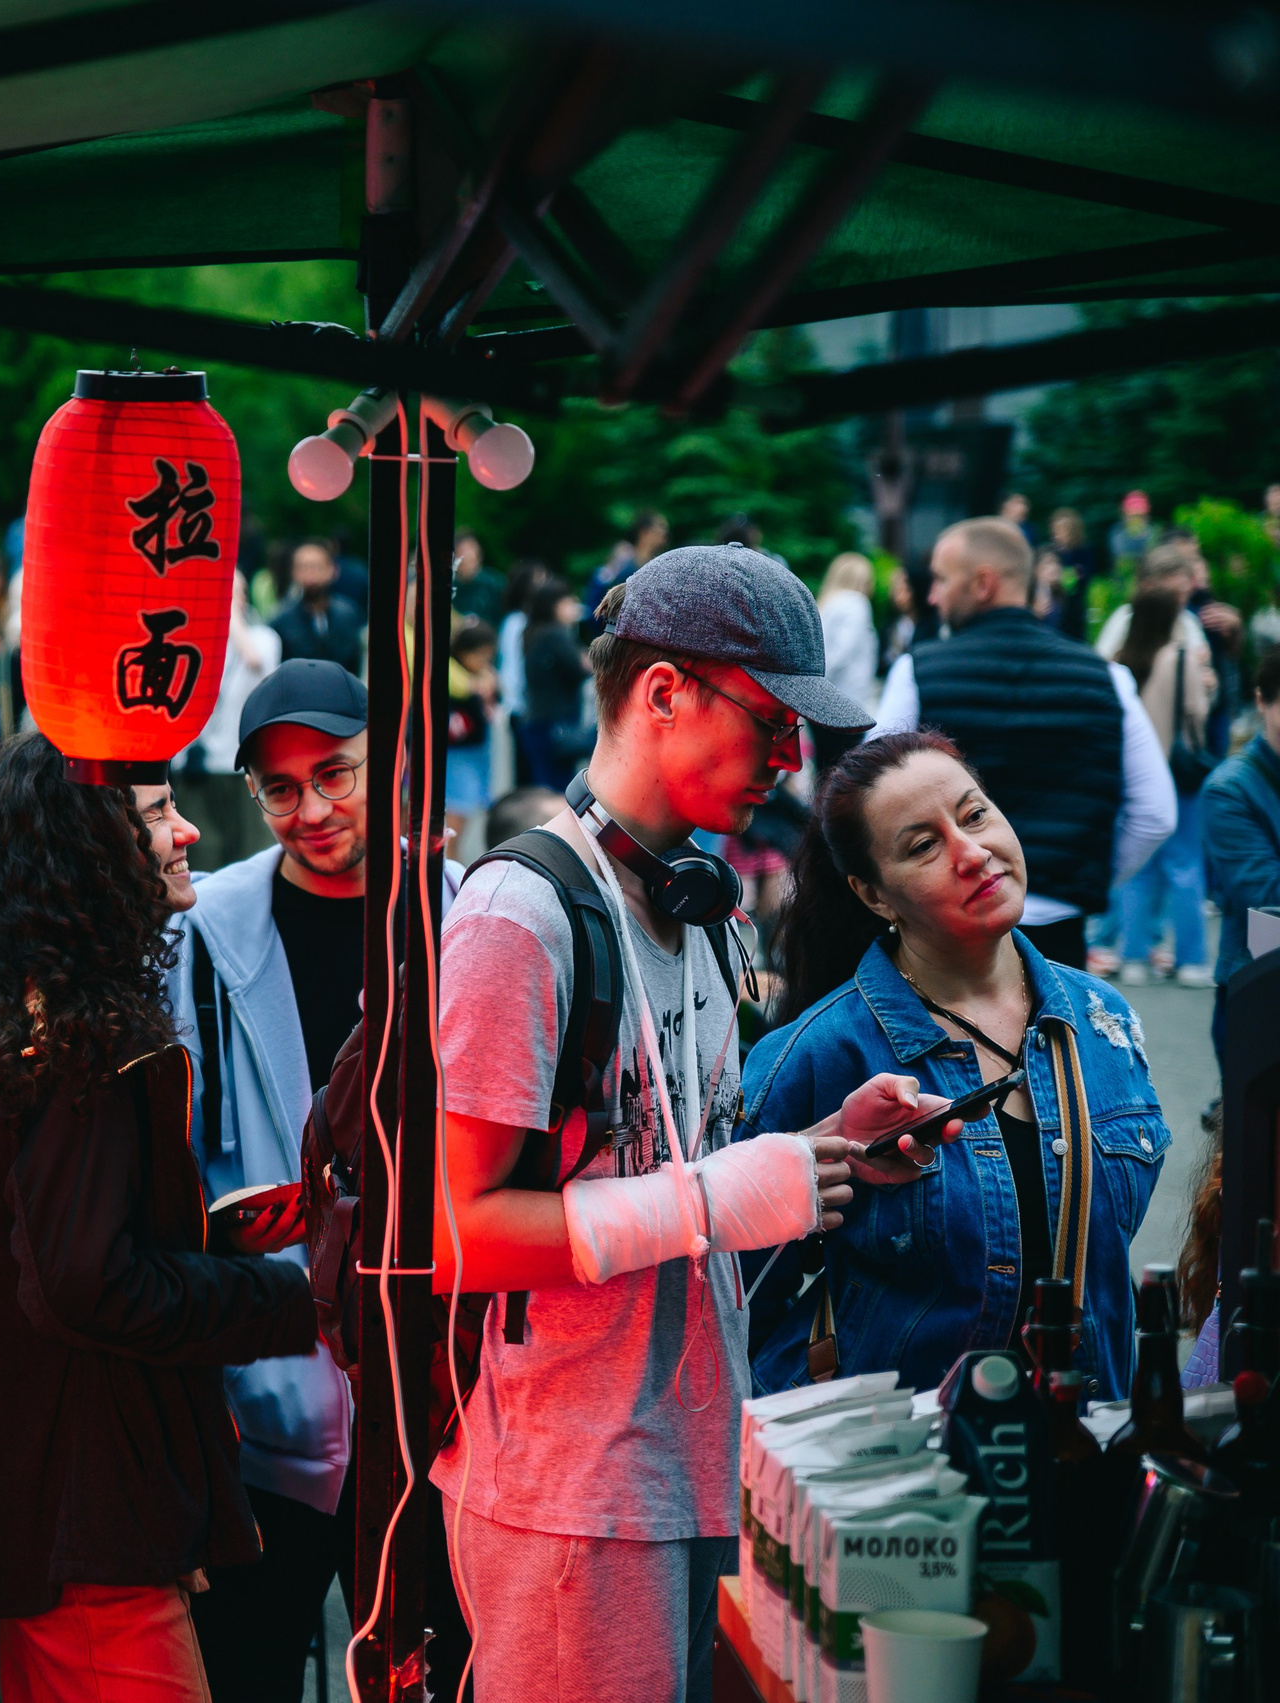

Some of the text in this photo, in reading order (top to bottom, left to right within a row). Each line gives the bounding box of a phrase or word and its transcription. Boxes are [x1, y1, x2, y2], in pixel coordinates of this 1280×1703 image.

[115, 457, 222, 721] 拉面
[672, 895, 689, 913] SONY
[977, 1423, 1031, 1550] Rich
[844, 1536, 958, 1558] МОЛОКО
